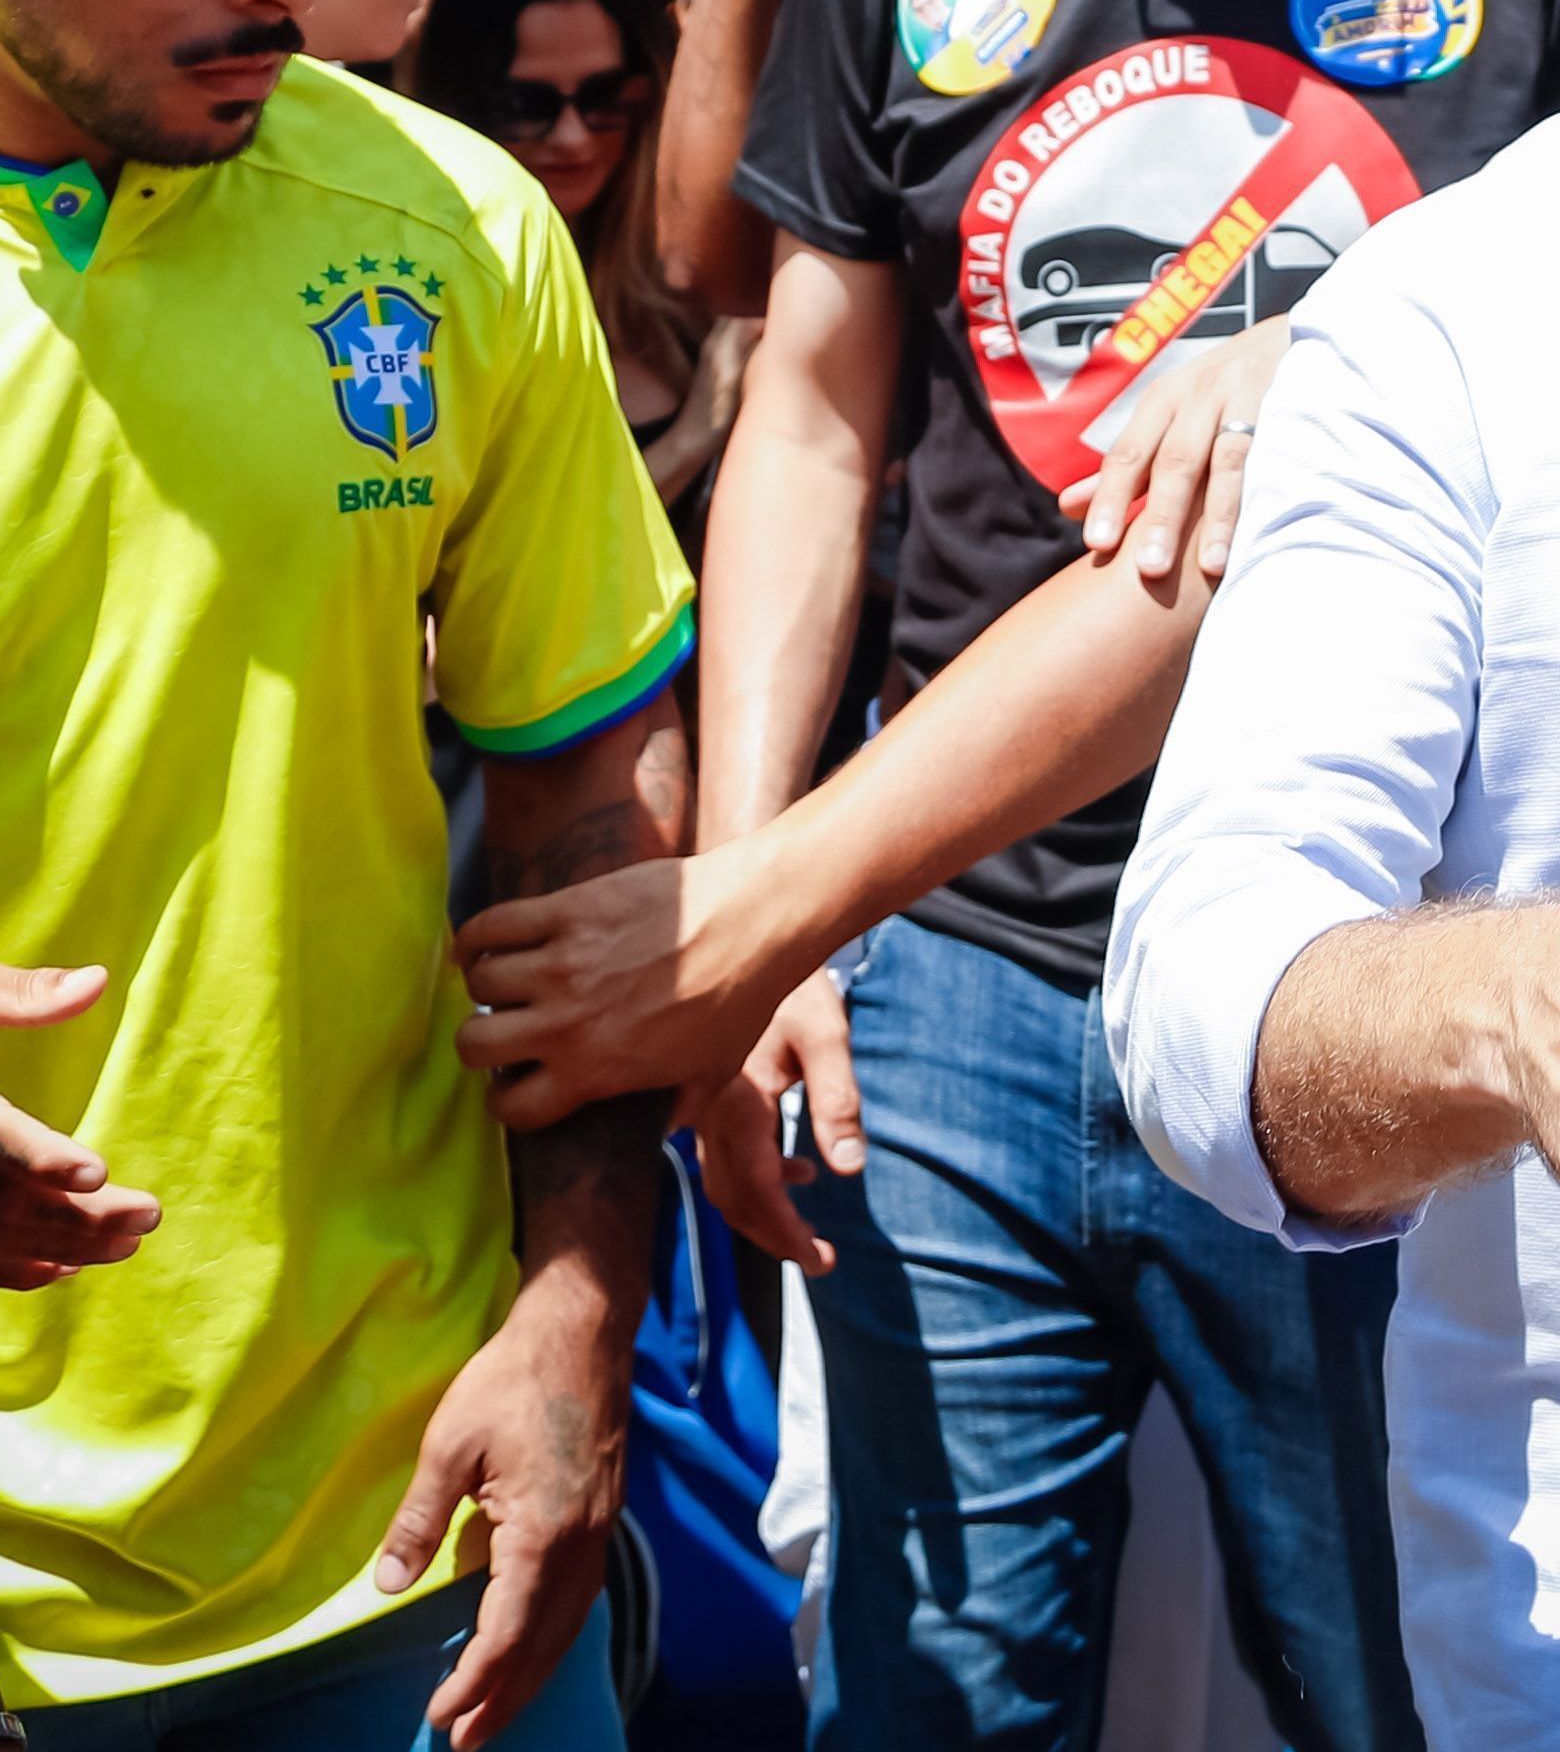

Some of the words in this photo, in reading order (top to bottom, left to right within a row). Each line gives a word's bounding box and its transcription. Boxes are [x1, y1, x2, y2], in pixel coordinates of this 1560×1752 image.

[1018, 44, 1211, 162] REBOQUE
[977, 159, 1032, 223] DO
[967, 232, 1017, 361] MAFIA
[1112, 196, 1268, 365] CHEGA!
[366, 353, 409, 374] CBF
